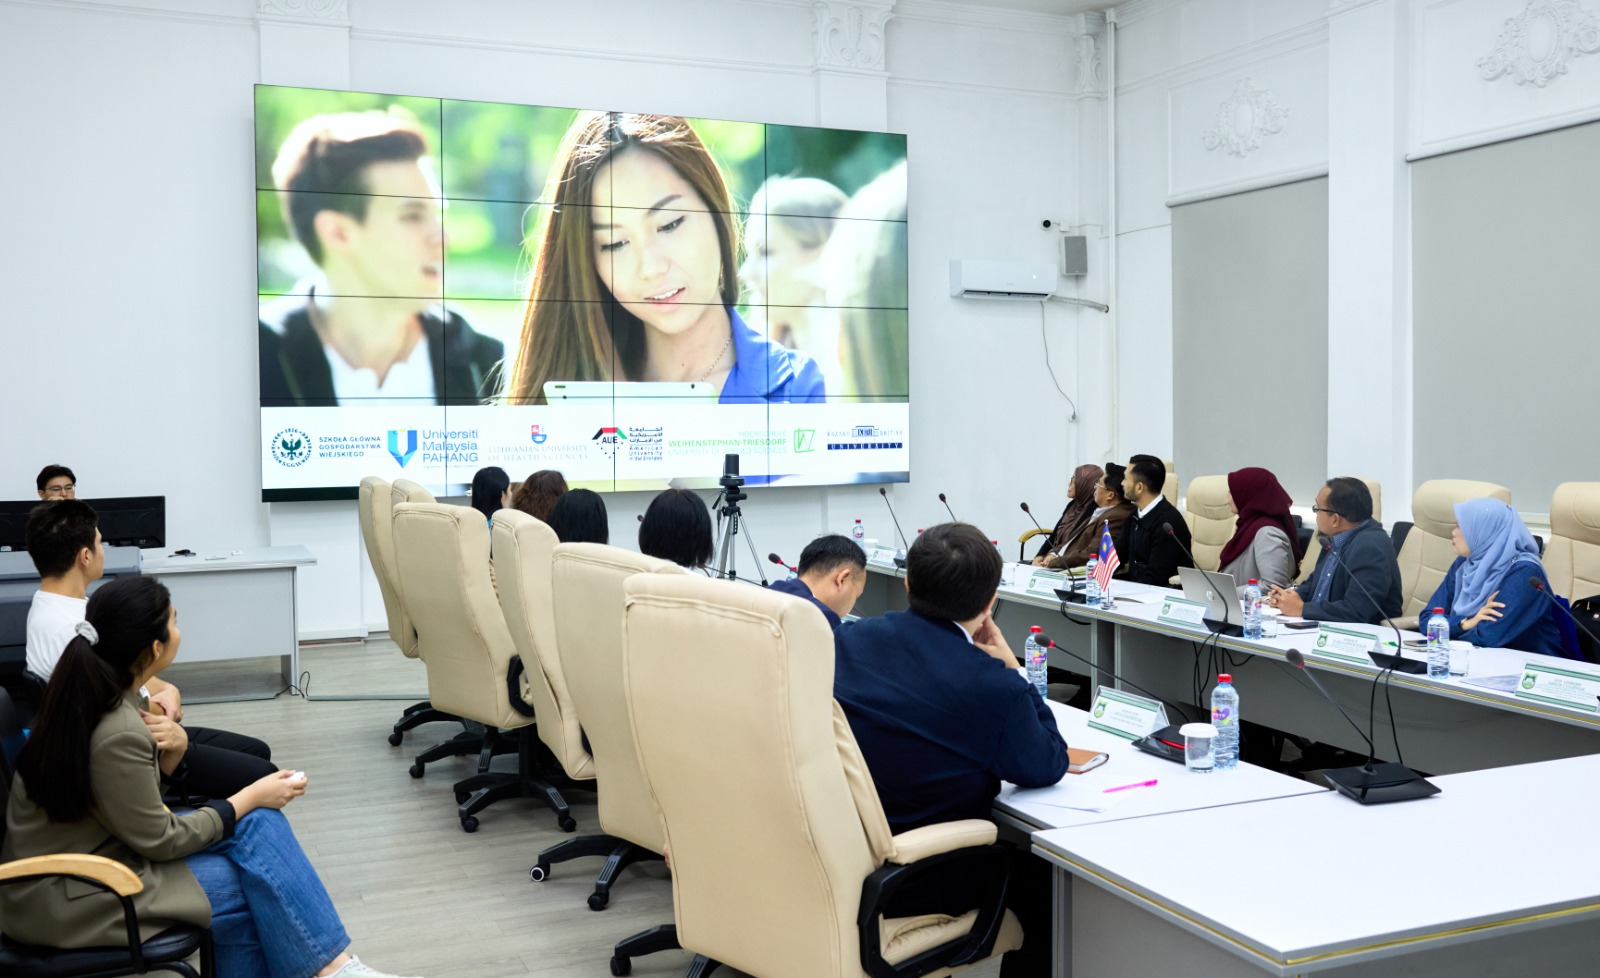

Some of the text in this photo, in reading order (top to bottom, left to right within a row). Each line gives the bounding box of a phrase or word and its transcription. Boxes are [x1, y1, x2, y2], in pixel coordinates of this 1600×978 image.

[422, 429, 479, 440] Universiti
[601, 436, 619, 444] AUE
[422, 441, 478, 452] Malaysia
[488, 446, 540, 454] LITHUANIAN
[422, 453, 479, 463] PAHANG
